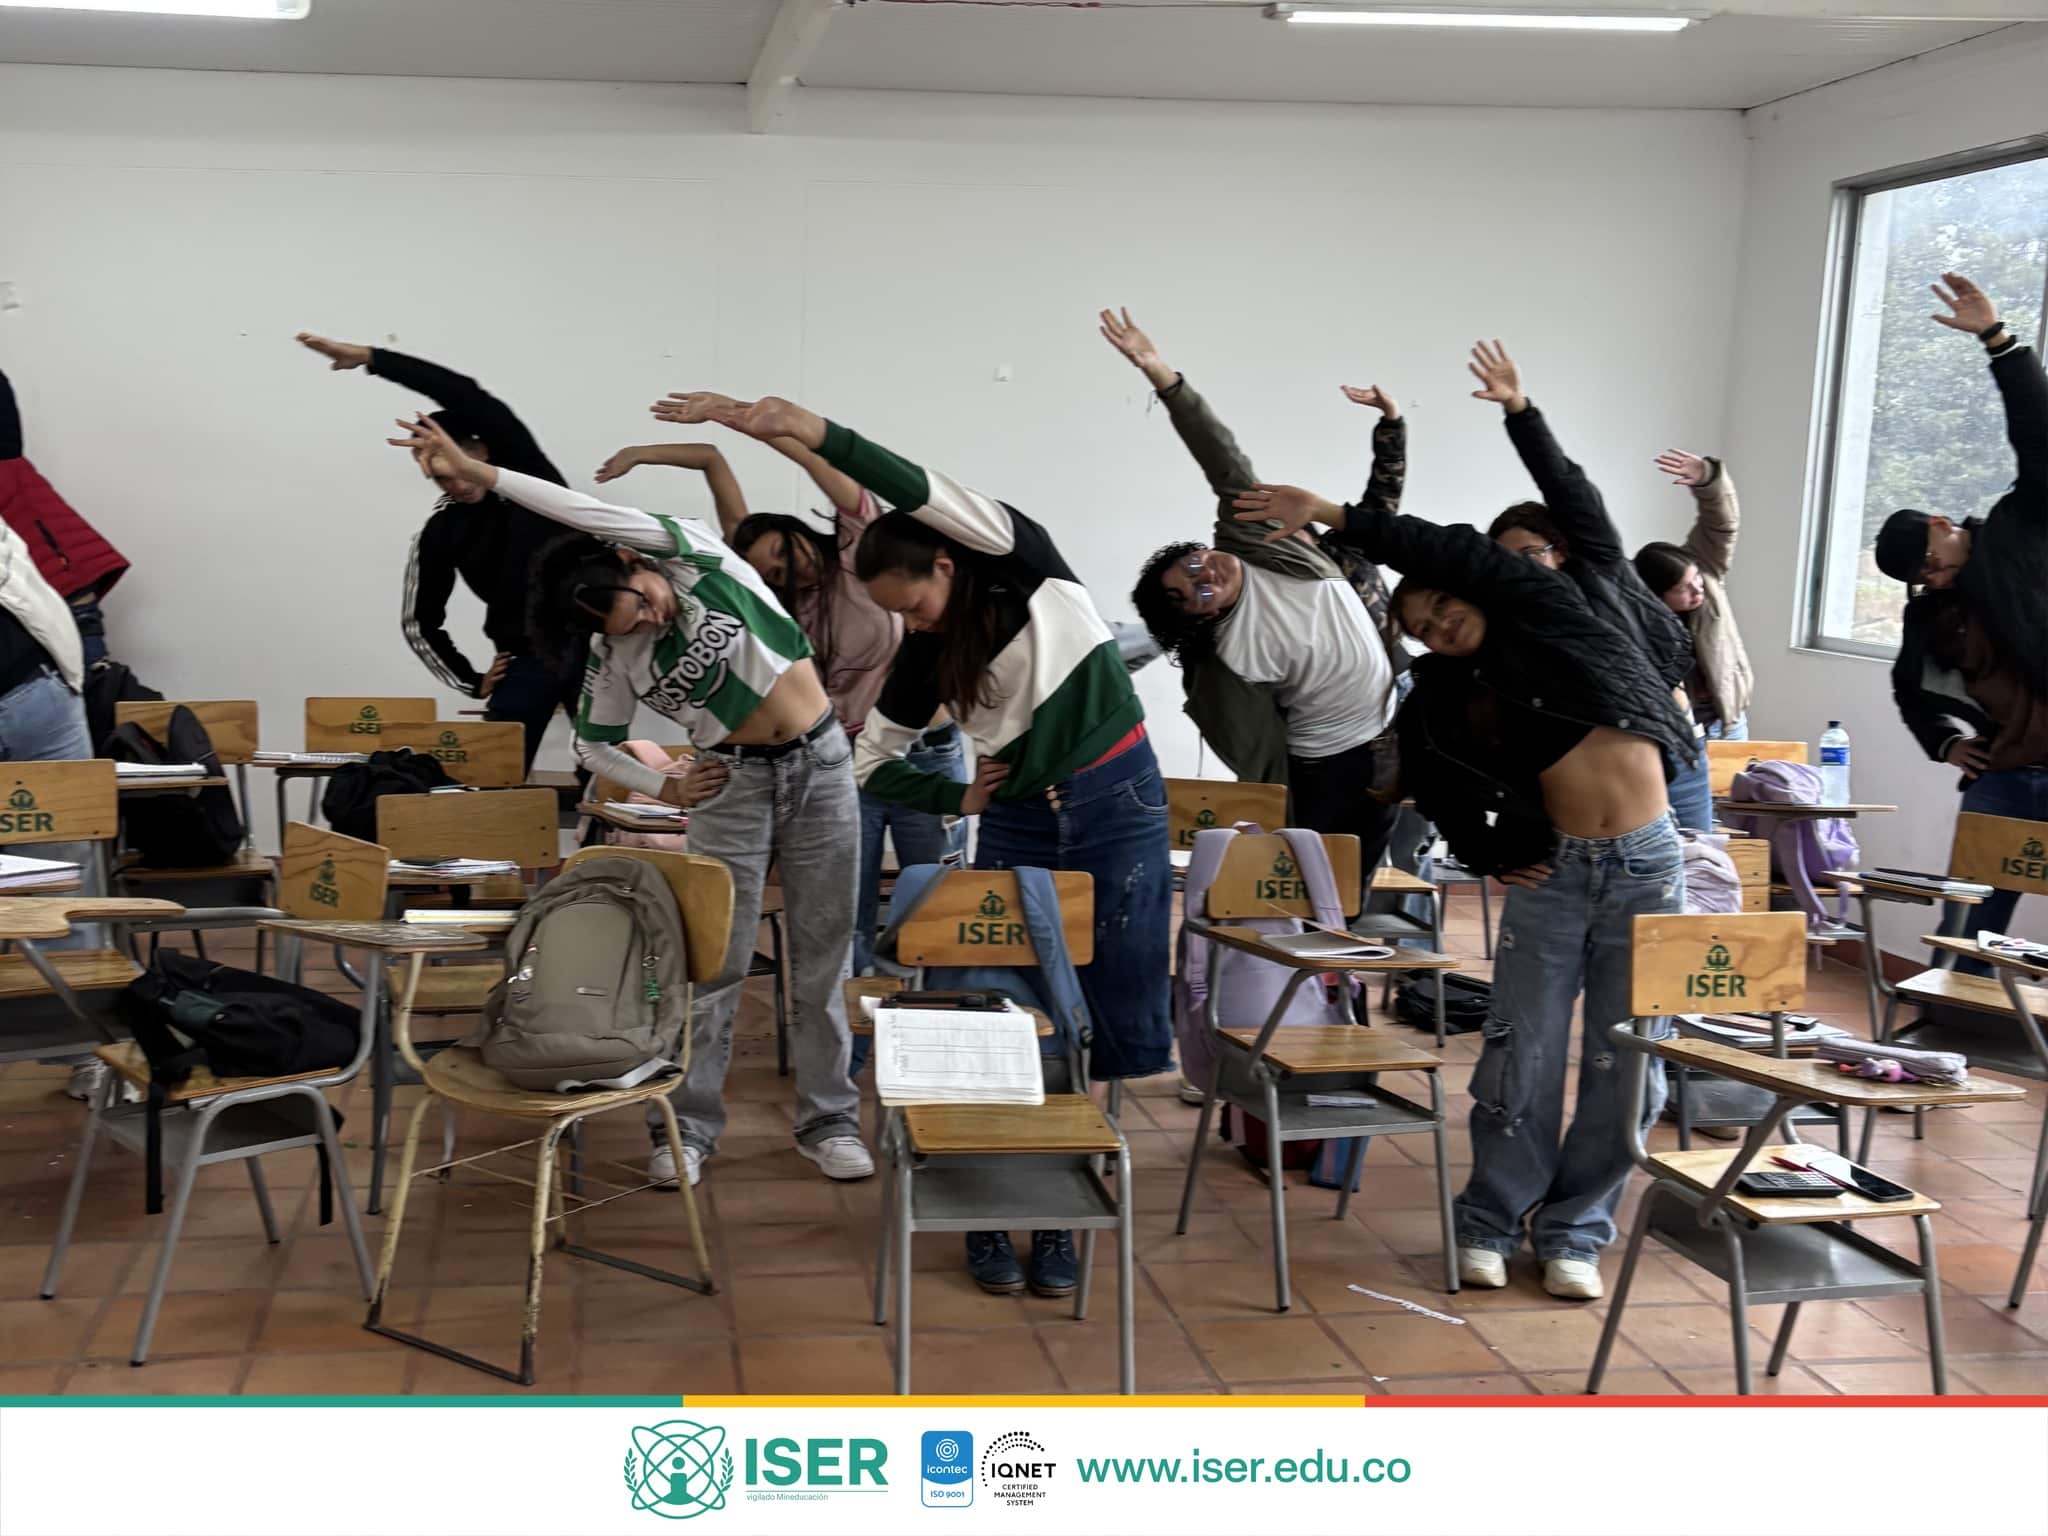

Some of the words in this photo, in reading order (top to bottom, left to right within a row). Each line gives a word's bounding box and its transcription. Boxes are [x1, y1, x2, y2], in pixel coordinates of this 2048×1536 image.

[434, 750, 468, 763] SER
[0, 812, 55, 833] SER
[958, 922, 1025, 945] ISER
[1686, 974, 1746, 998] ISER
